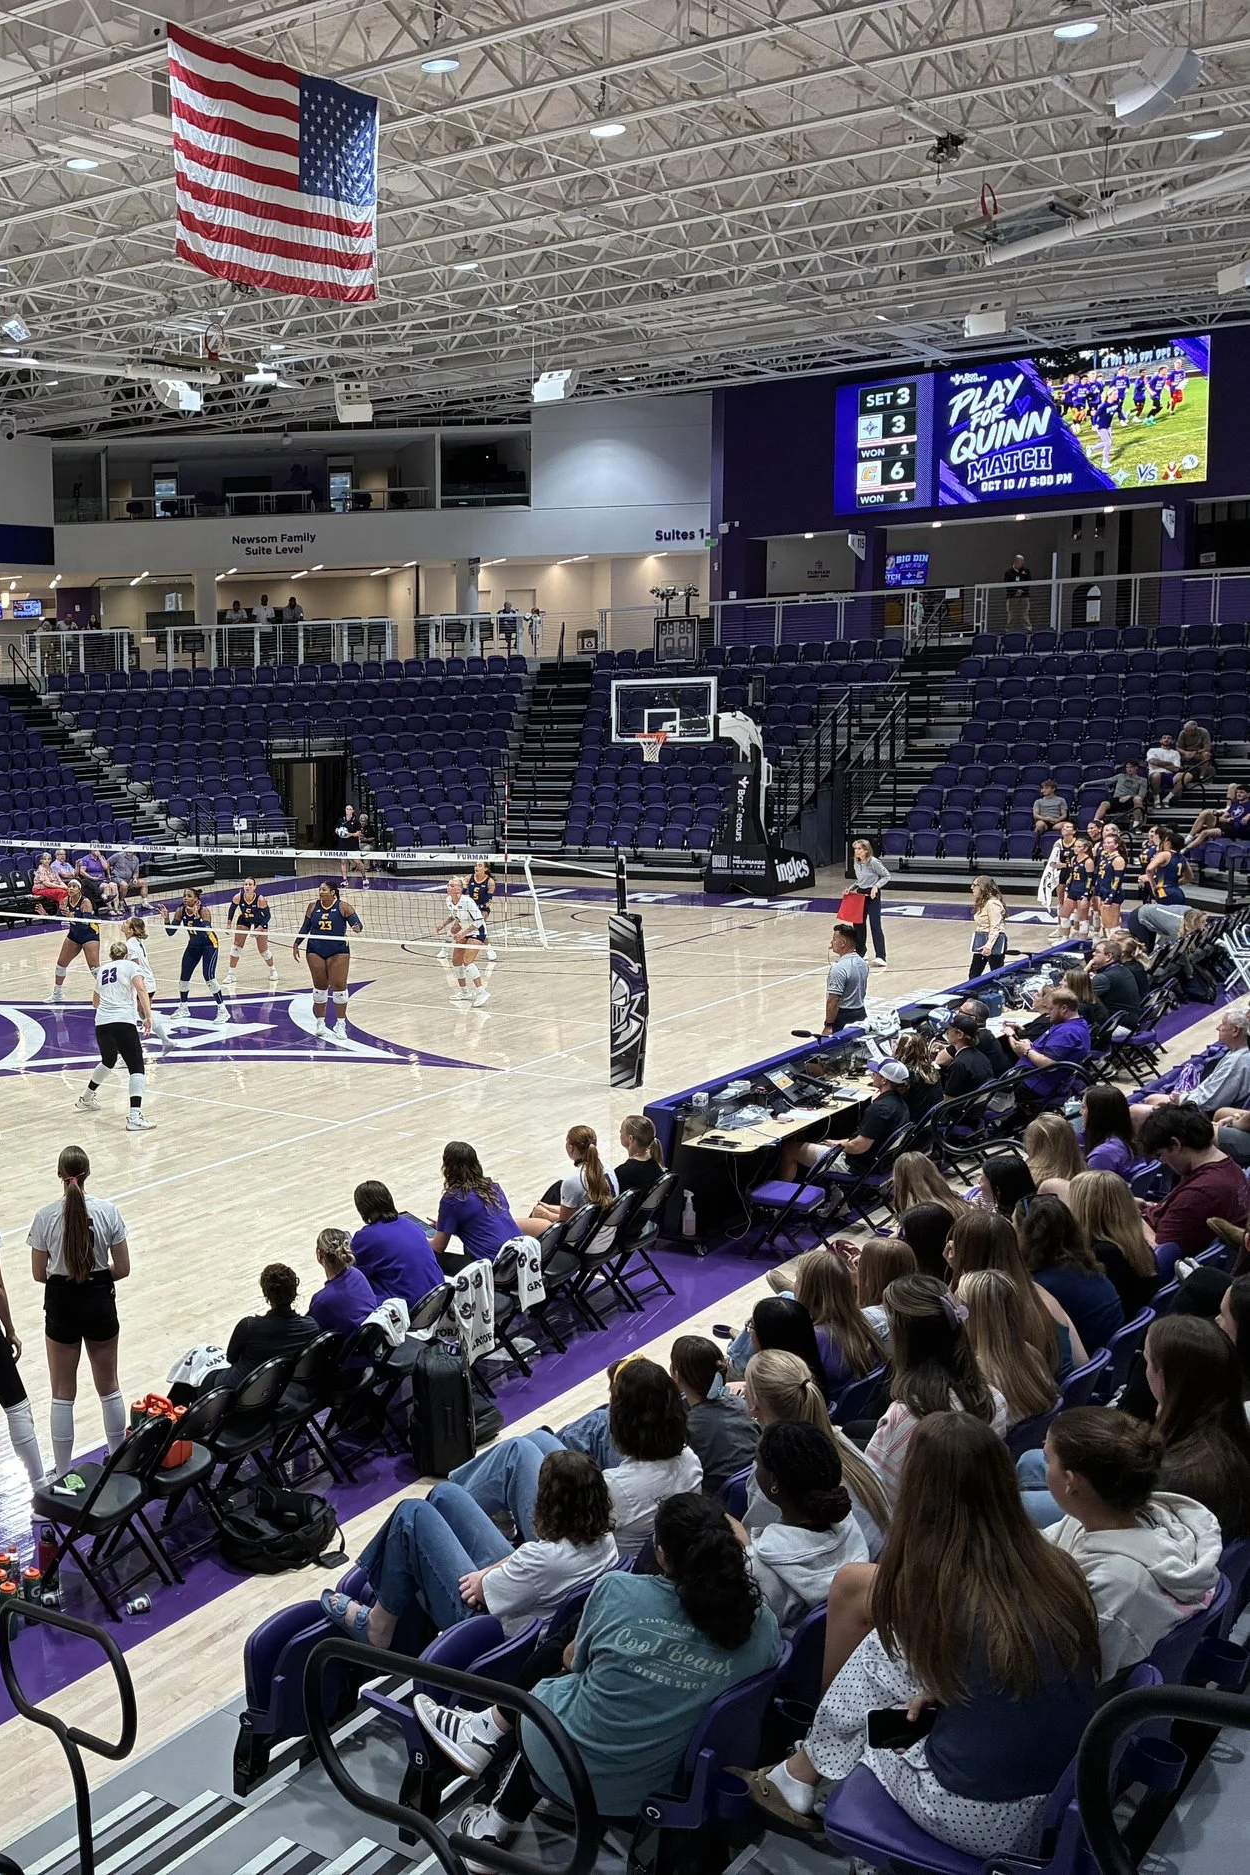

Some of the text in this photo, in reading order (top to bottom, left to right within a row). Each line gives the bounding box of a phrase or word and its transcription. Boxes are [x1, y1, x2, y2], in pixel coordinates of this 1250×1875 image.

[866, 387, 910, 407] SET 3
[948, 374, 1024, 428] PLAY
[892, 415, 906, 433] 3
[970, 403, 1007, 432] FOR
[950, 406, 1052, 465] QUINN
[861, 444, 909, 458] WON 1
[890, 461, 905, 480] 6
[967, 446, 1052, 485] MATCH
[981, 480, 1001, 492] OCT
[1004, 479, 1014, 489] 10
[1029, 475, 1053, 487] 5:00
[1056, 473, 1072, 485] PM
[860, 491, 908, 504] WON 1
[232, 532, 316, 544] Newsom Family
[655, 529, 695, 542] Suites
[245, 544, 303, 555] Suite Level
[896, 555, 911, 564] BIG
[774, 857, 810, 884] ingles
[319, 921, 333, 931] 23
[101, 967, 118, 986] 23
[614, 1627, 663, 1656] Cool
[667, 1642, 733, 1677] Beans
[628, 1661, 671, 1686] COFFEE
[675, 1680, 708, 1690] SHOP
[415, 1752, 424, 1765] B
[646, 1806, 661, 1820] C
